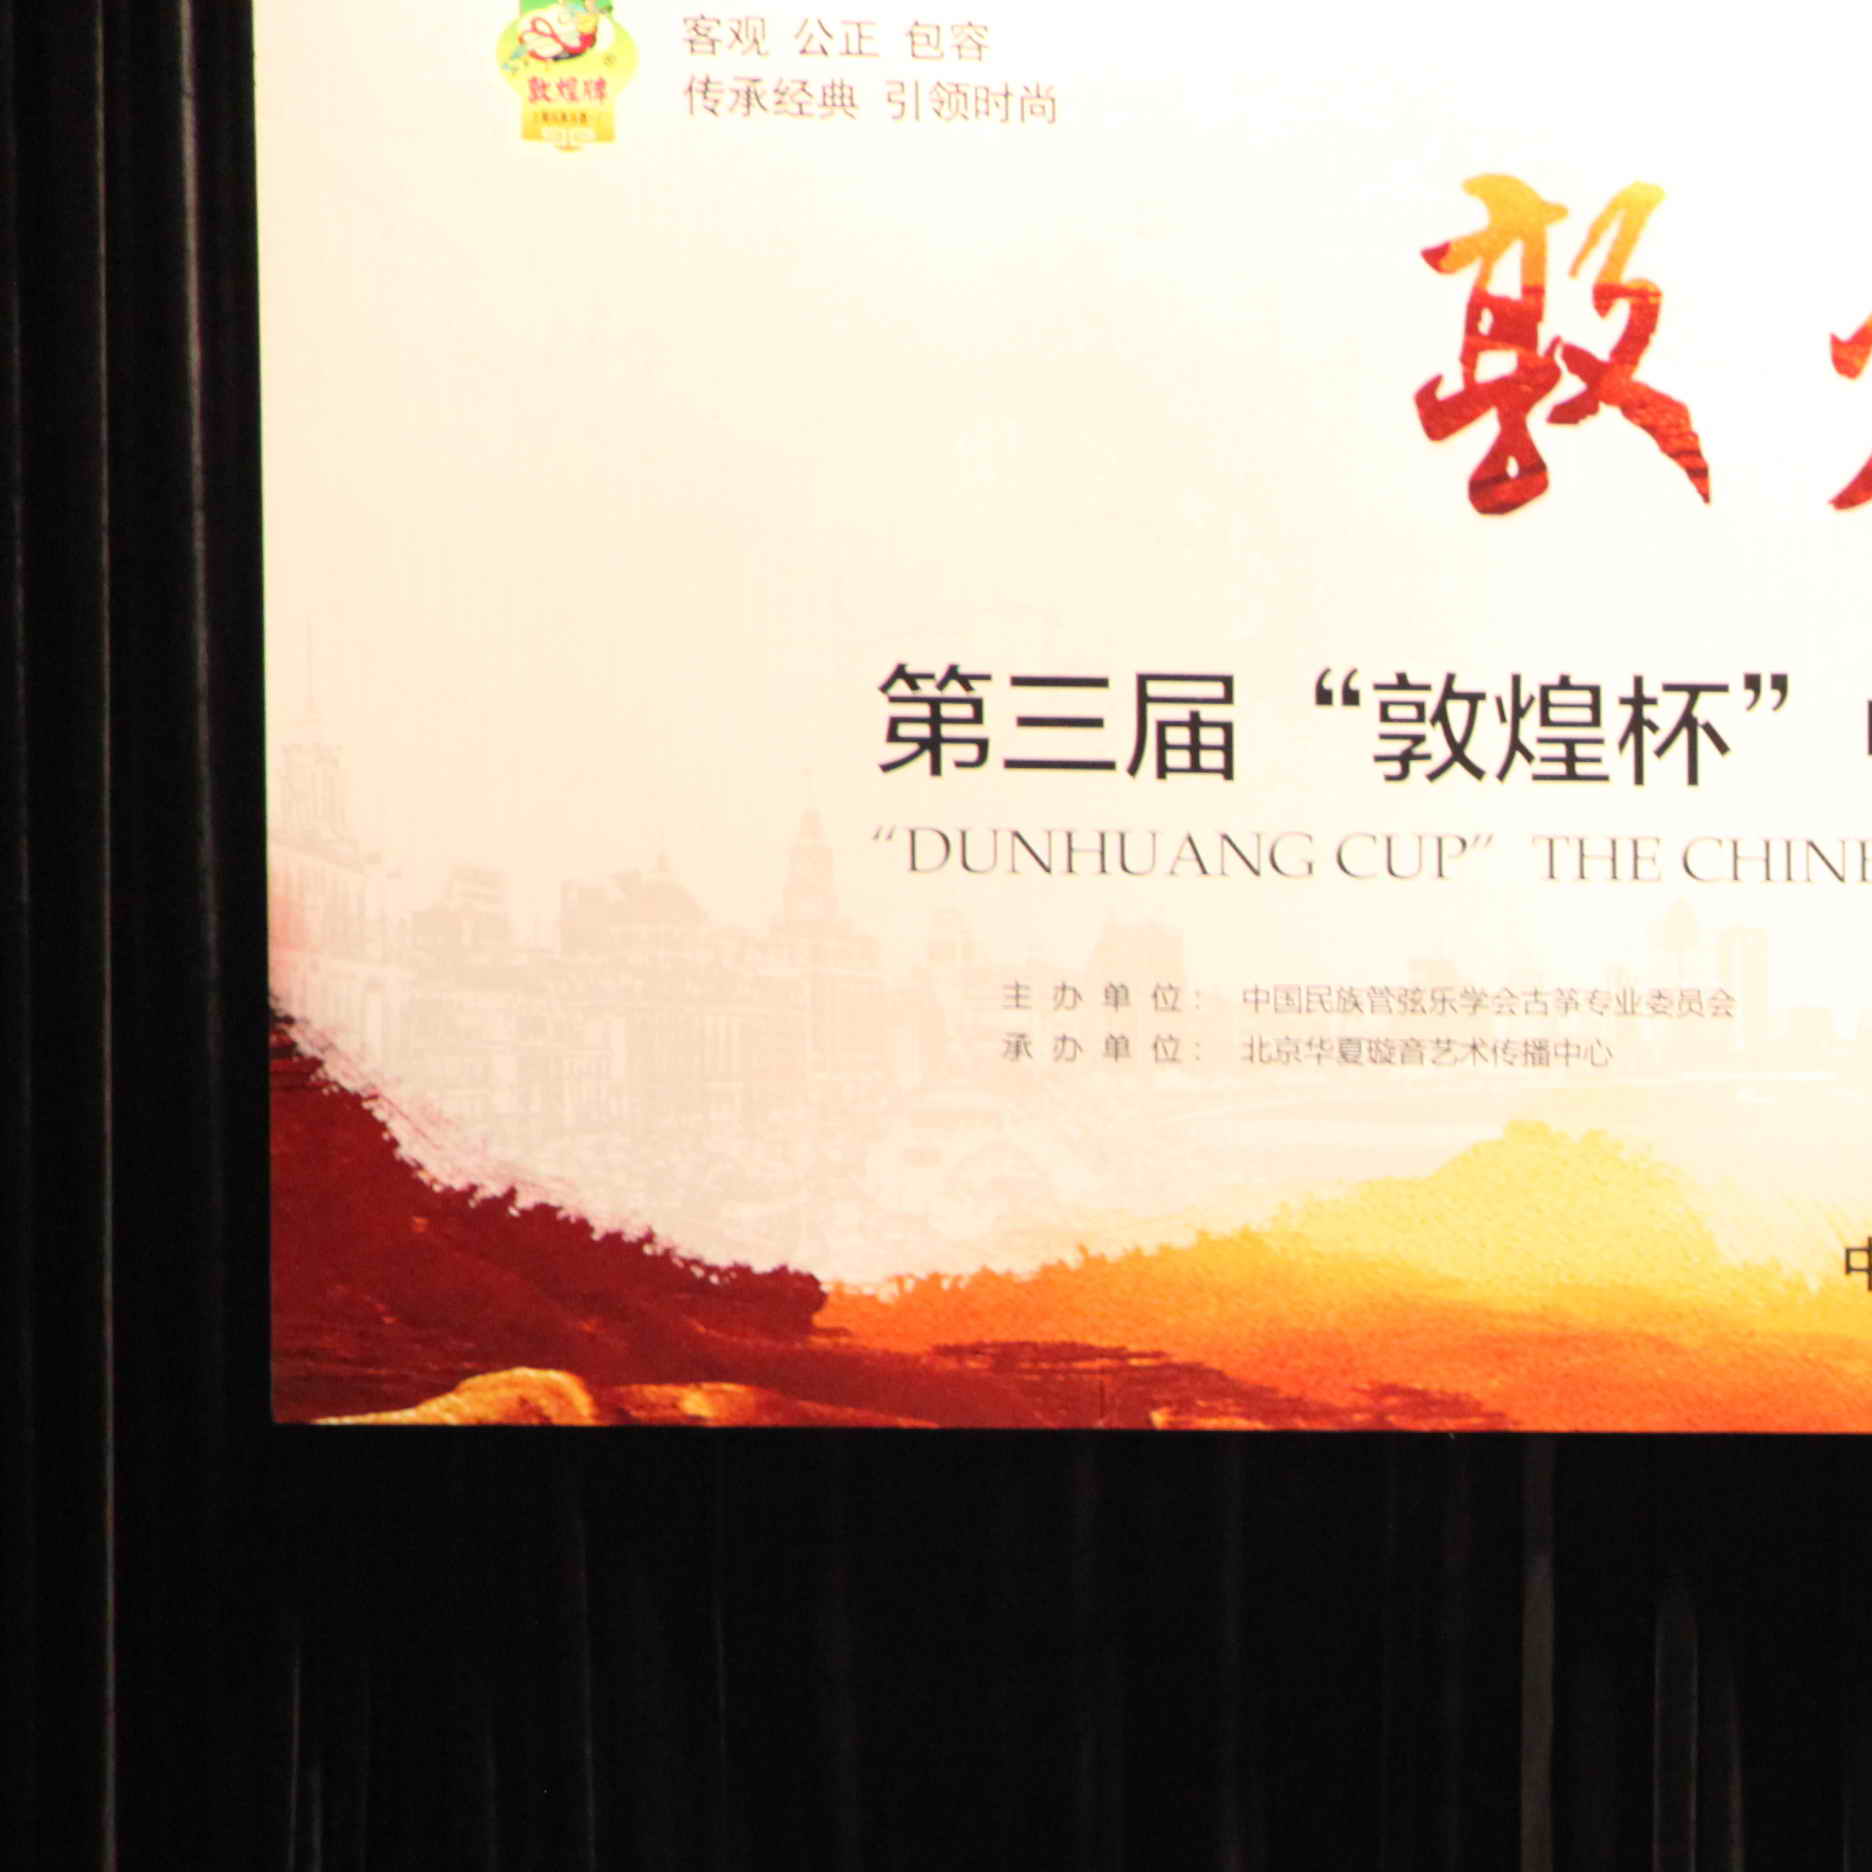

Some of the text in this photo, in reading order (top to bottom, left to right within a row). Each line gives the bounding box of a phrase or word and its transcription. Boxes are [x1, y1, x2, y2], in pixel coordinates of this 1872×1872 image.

[683, 14, 991, 62] 客观 公正 包容
[683, 74, 1058, 126] 传承经典 引领时尚
[877, 663, 1236, 782] 第三届
[1313, 667, 1790, 787] “敦煌杯”
[1531, 833, 1664, 884] THE
